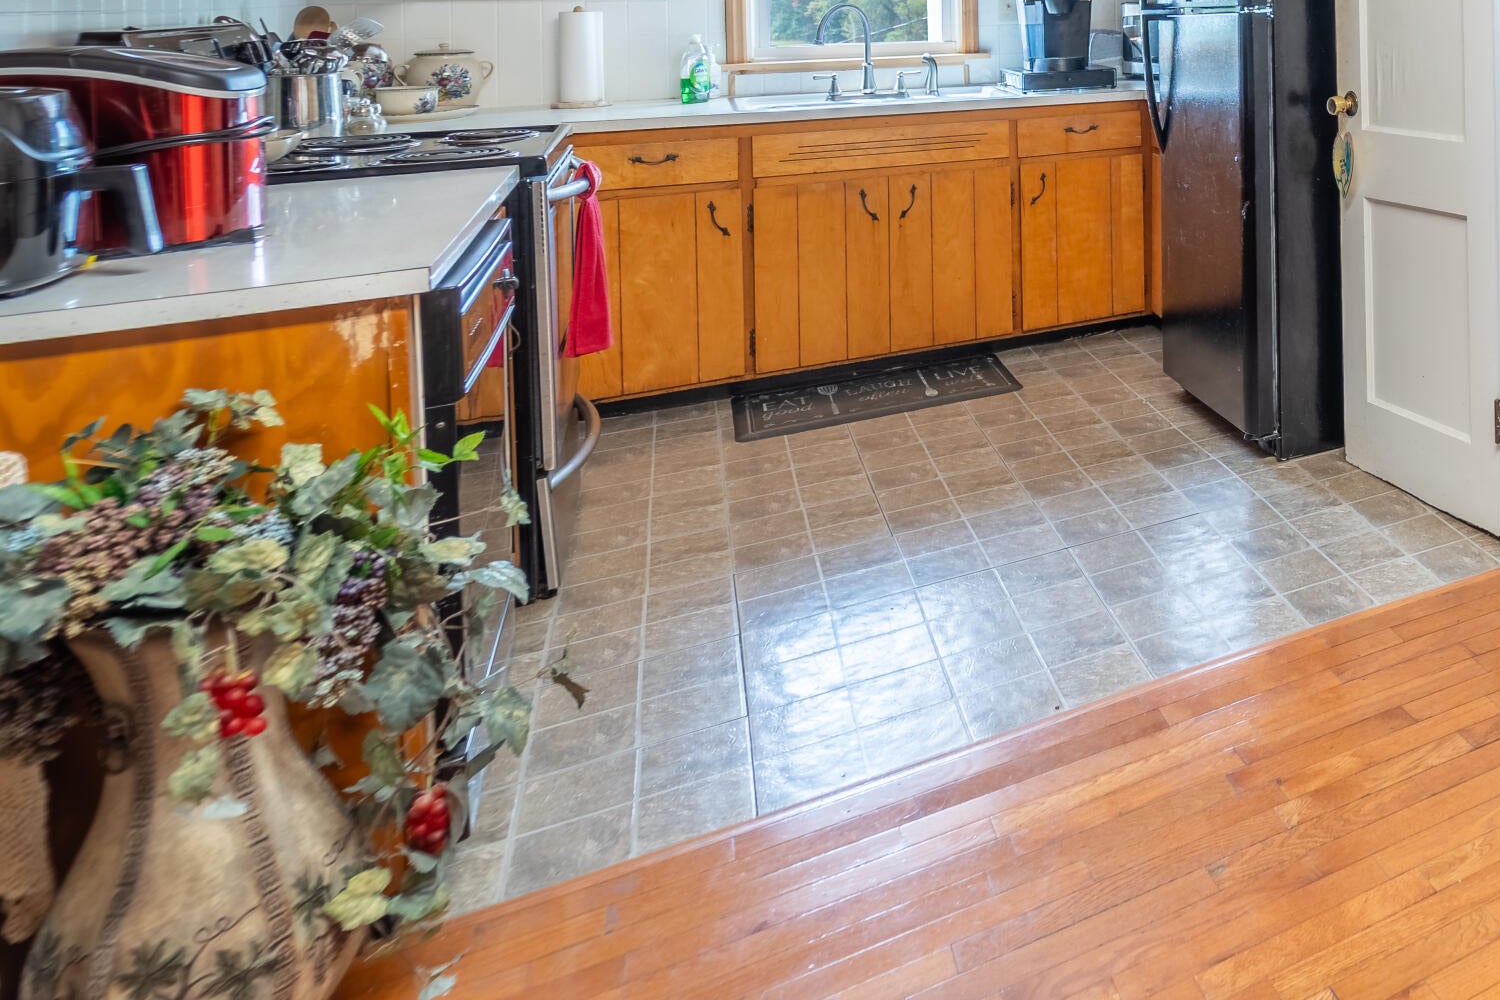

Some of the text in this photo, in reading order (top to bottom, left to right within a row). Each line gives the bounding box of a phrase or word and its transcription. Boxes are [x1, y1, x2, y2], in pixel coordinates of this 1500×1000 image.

[934, 365, 981, 380] LIVE
[845, 379, 913, 396] LAUGH
[762, 395, 809, 412] EAT
[762, 402, 814, 421] good
